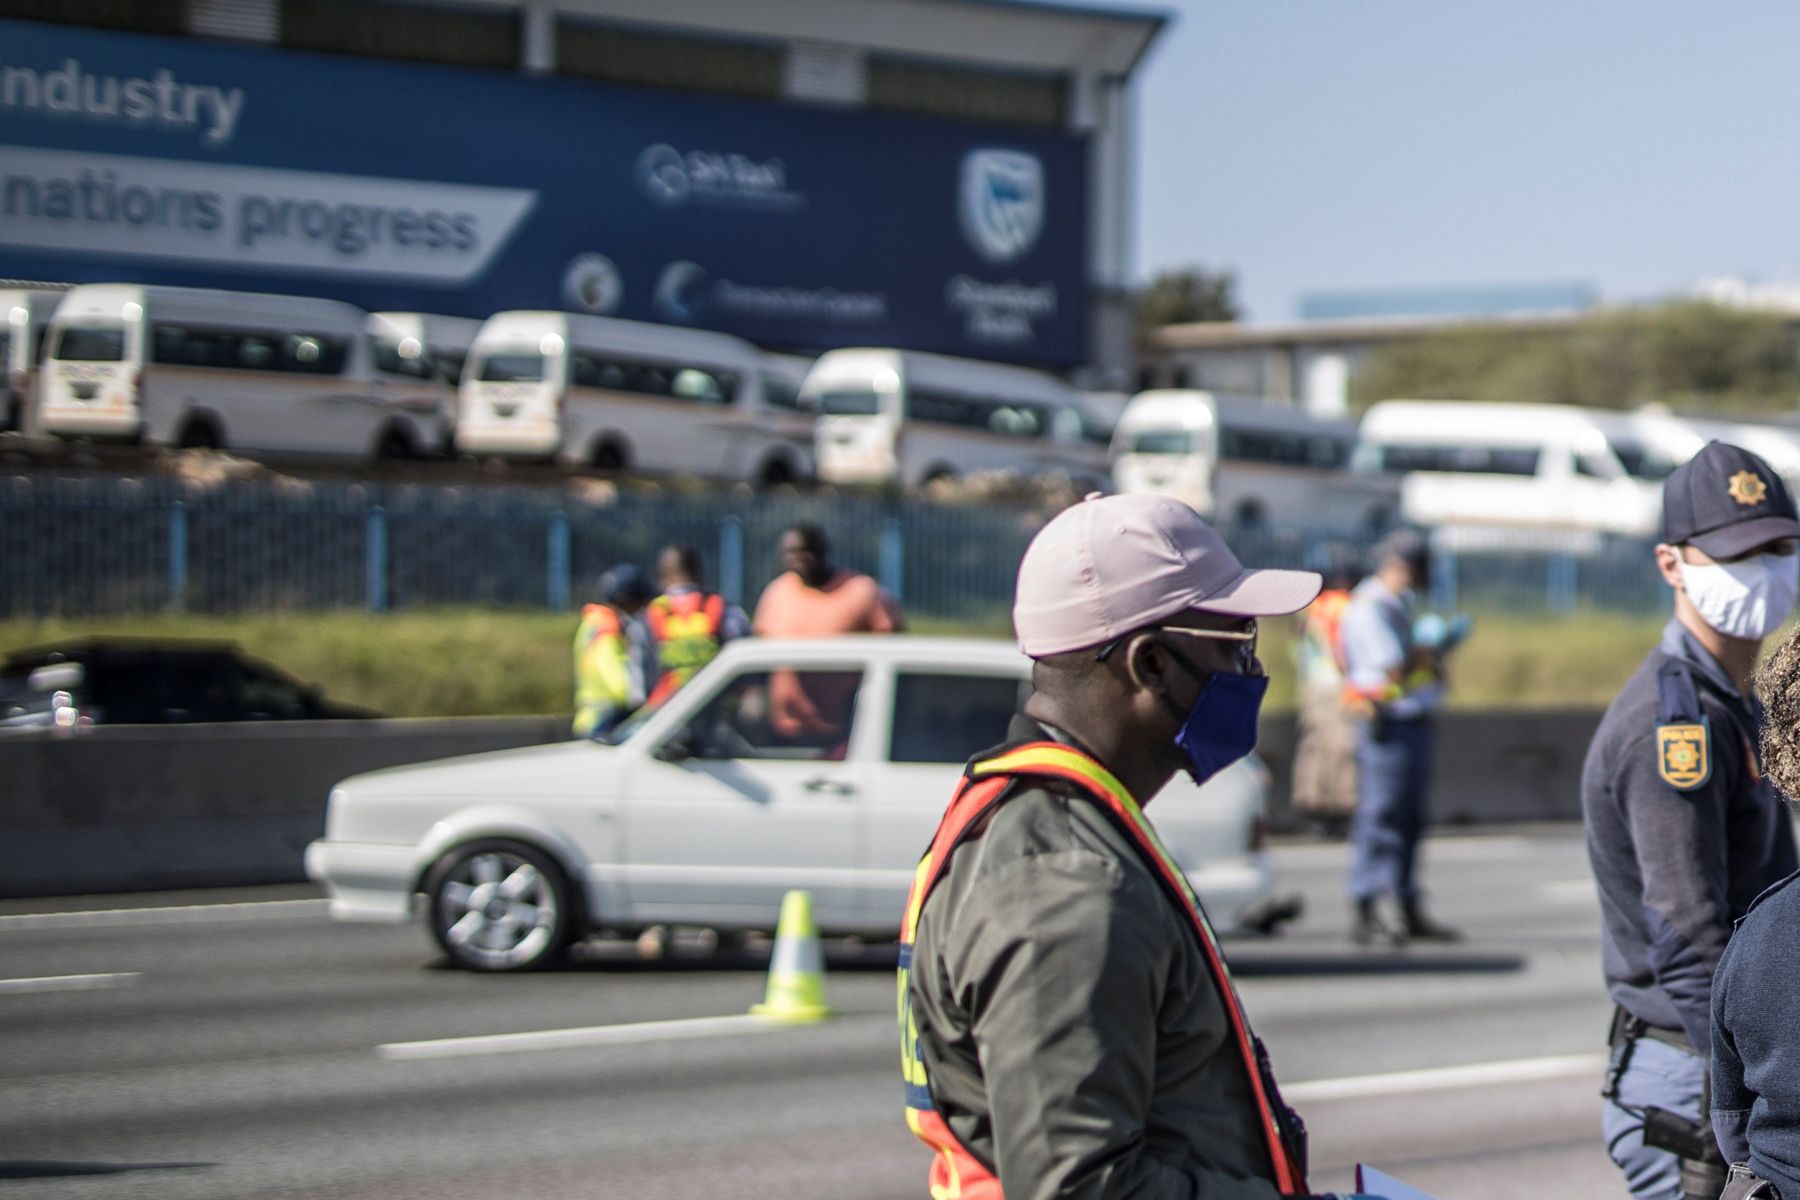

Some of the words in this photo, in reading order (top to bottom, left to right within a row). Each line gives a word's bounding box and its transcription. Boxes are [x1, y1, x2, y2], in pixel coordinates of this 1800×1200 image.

[2, 57, 246, 143] ndustry
[4, 168, 224, 231] nations
[239, 193, 480, 254] progress
